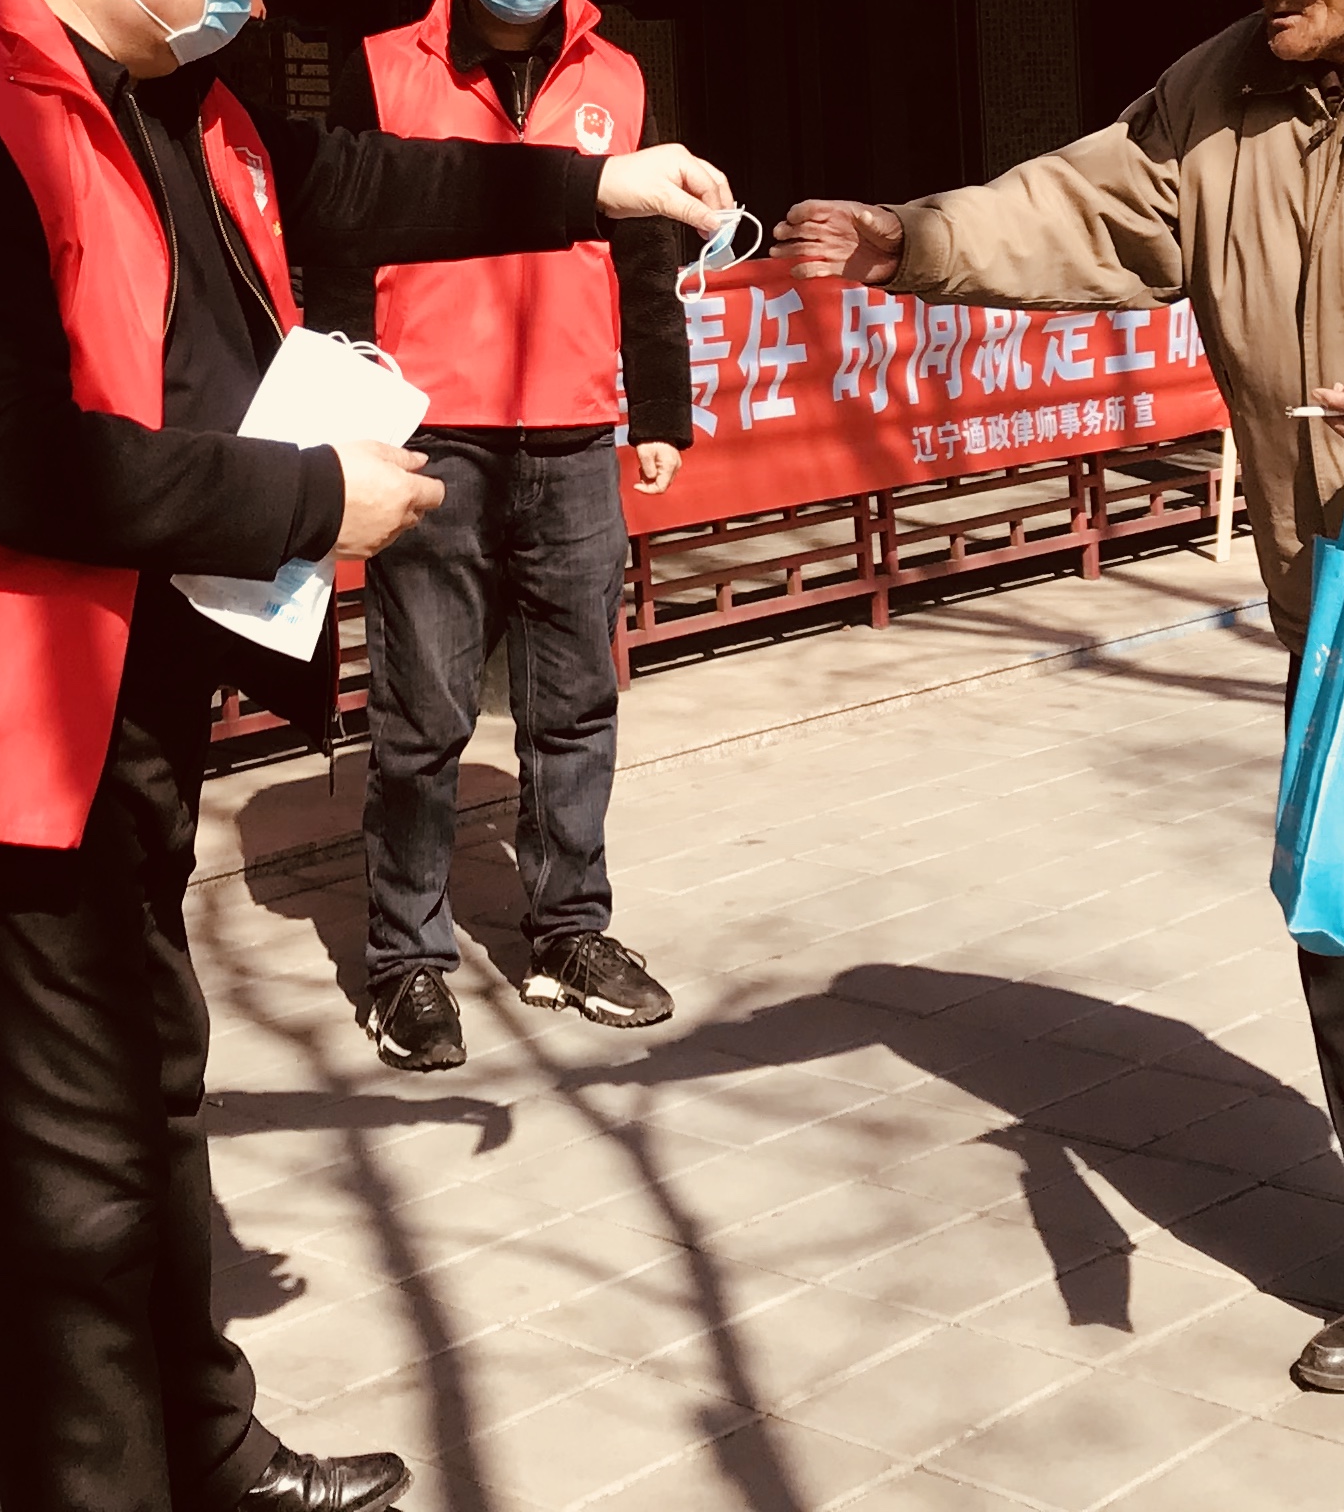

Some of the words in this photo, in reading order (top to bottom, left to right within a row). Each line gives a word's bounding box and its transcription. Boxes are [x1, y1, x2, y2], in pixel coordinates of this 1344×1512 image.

[913, 396, 1126, 464] 辽宁通政律师事务所
[1133, 392, 1156, 429] 宣
